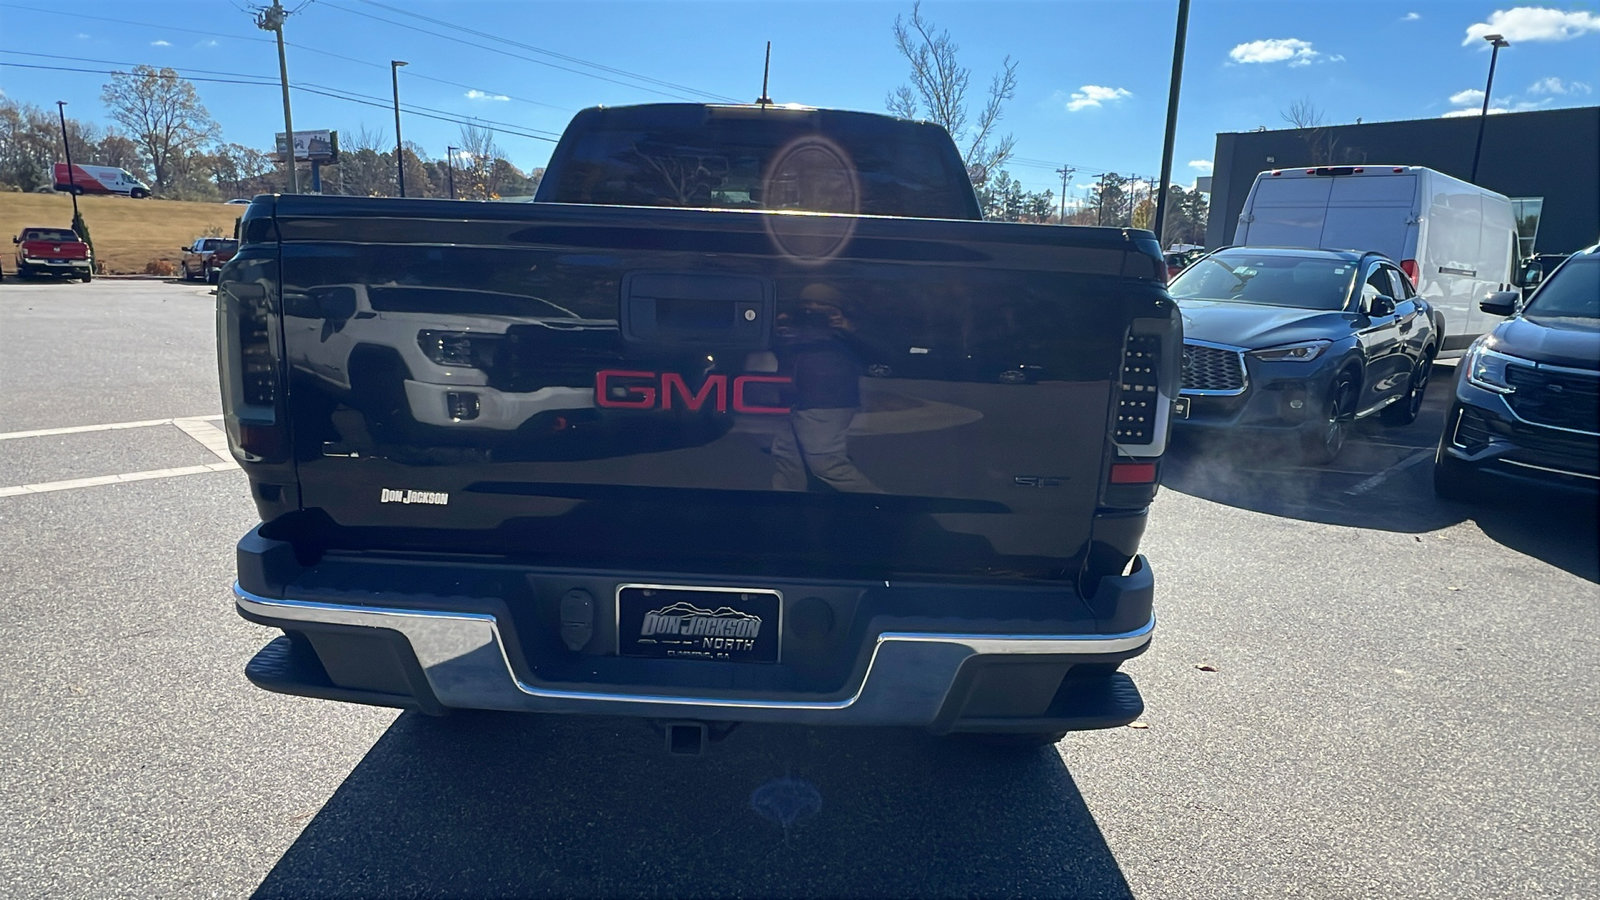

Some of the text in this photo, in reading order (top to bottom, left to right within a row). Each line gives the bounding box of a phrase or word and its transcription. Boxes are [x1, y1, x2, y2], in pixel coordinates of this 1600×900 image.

[596, 369, 792, 413] GMC
[381, 488, 449, 505] DON JACKSON
[641, 613, 762, 638] DON JACKSON
[702, 637, 755, 651] NORTH
